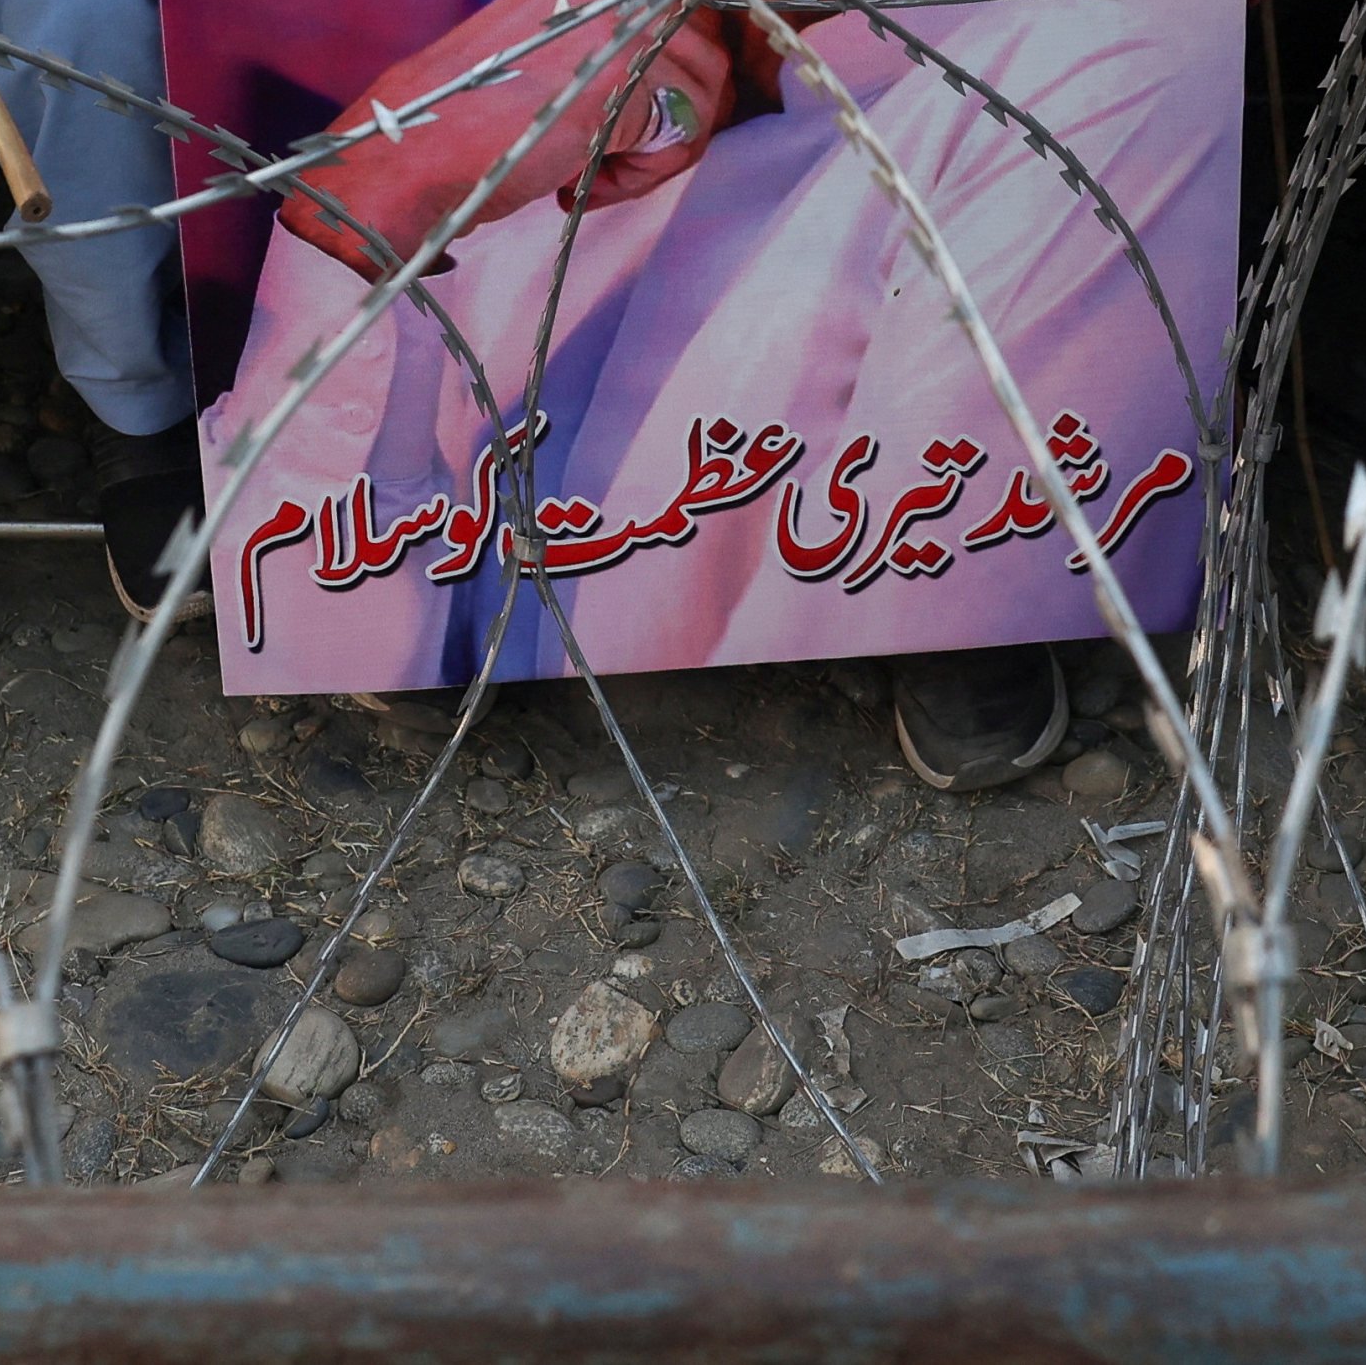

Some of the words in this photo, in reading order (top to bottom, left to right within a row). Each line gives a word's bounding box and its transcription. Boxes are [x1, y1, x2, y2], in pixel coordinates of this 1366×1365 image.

[237, 472, 450, 648] سلام
[425, 410, 547, 580] کو
[497, 414, 803, 572] عظمت
[773, 430, 986, 589] تیری
[960, 408, 1192, 569] مرشد
